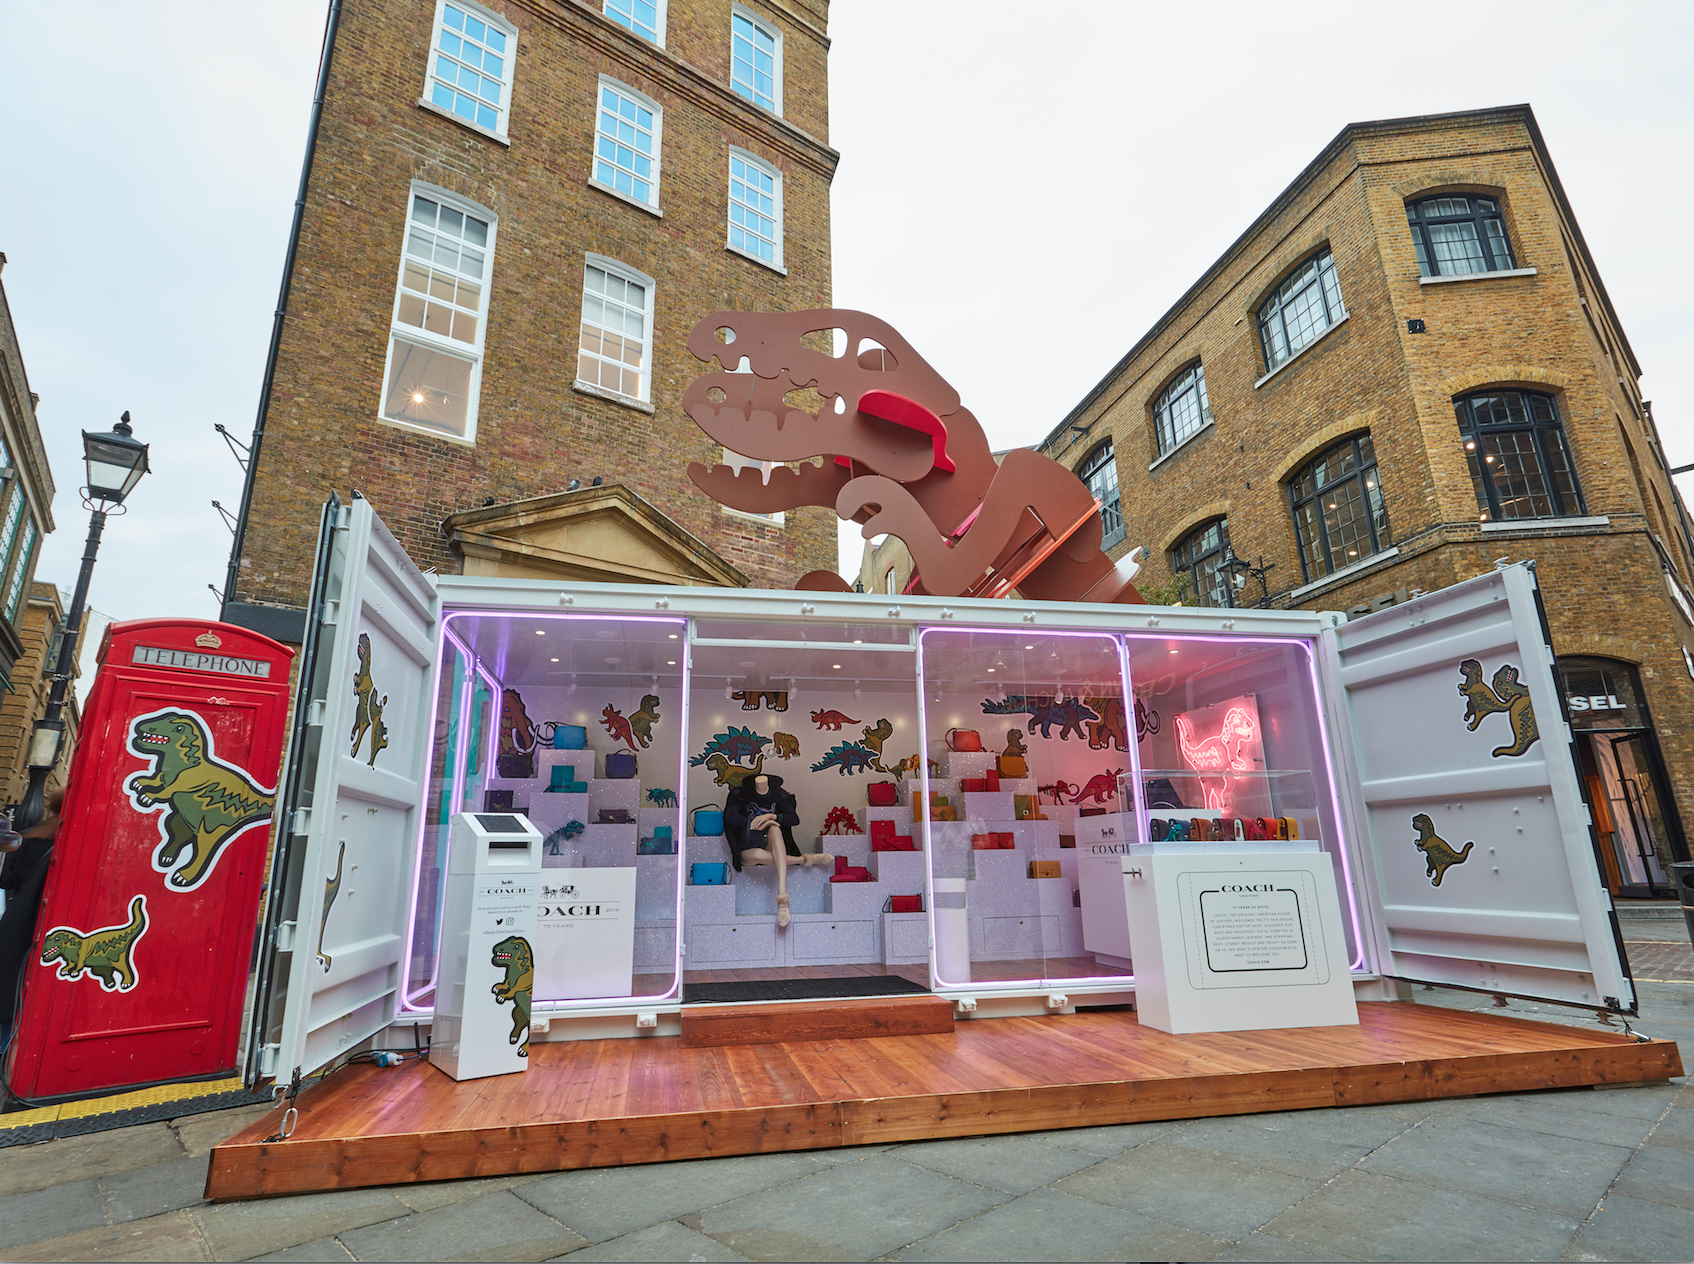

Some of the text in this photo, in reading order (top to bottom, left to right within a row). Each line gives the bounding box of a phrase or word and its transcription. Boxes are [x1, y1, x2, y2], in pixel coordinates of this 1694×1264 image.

[142, 647, 265, 676] TELEPHONE
[1566, 695, 1627, 711] SEL
[1092, 844, 1129, 854] COACH
[1221, 884, 1274, 893] COACH
[537, 905, 601, 917] OACH
